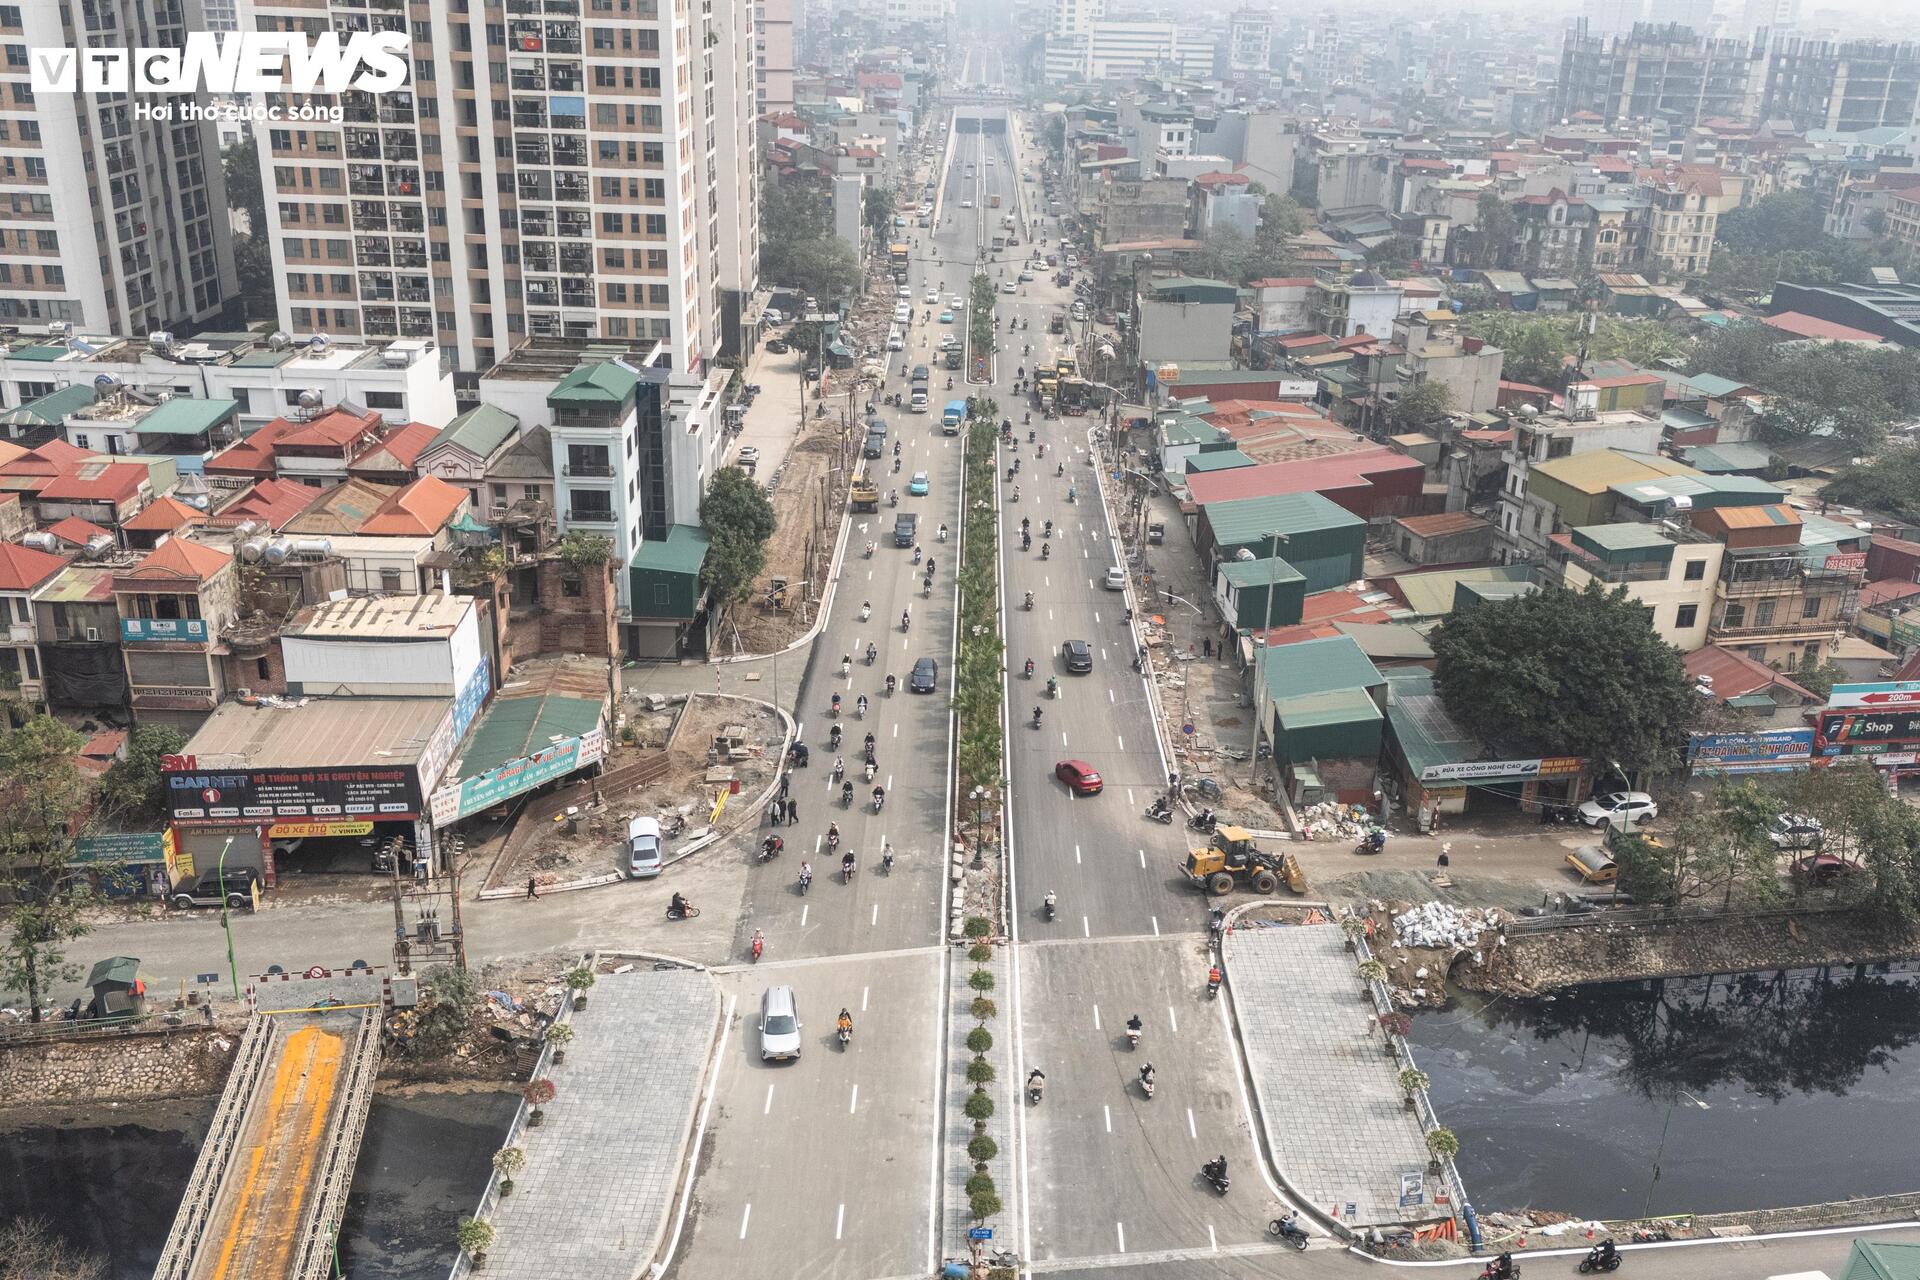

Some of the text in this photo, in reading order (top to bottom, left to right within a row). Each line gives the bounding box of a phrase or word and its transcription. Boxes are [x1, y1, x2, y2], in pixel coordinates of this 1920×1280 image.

[1888, 694, 1912, 702] 200m
[1865, 722, 1894, 735] Shop
[161, 754, 198, 771] 3M
[1442, 765, 1455, 774] RỬA
[1466, 764, 1486, 772] CÔNG
[1487, 762, 1505, 772] NGHỆ
[317, 773, 329, 782] XE
[331, 770, 369, 783] CHUYÊN
[206, 789, 216, 803] 1
[292, 825, 305, 833] XE
